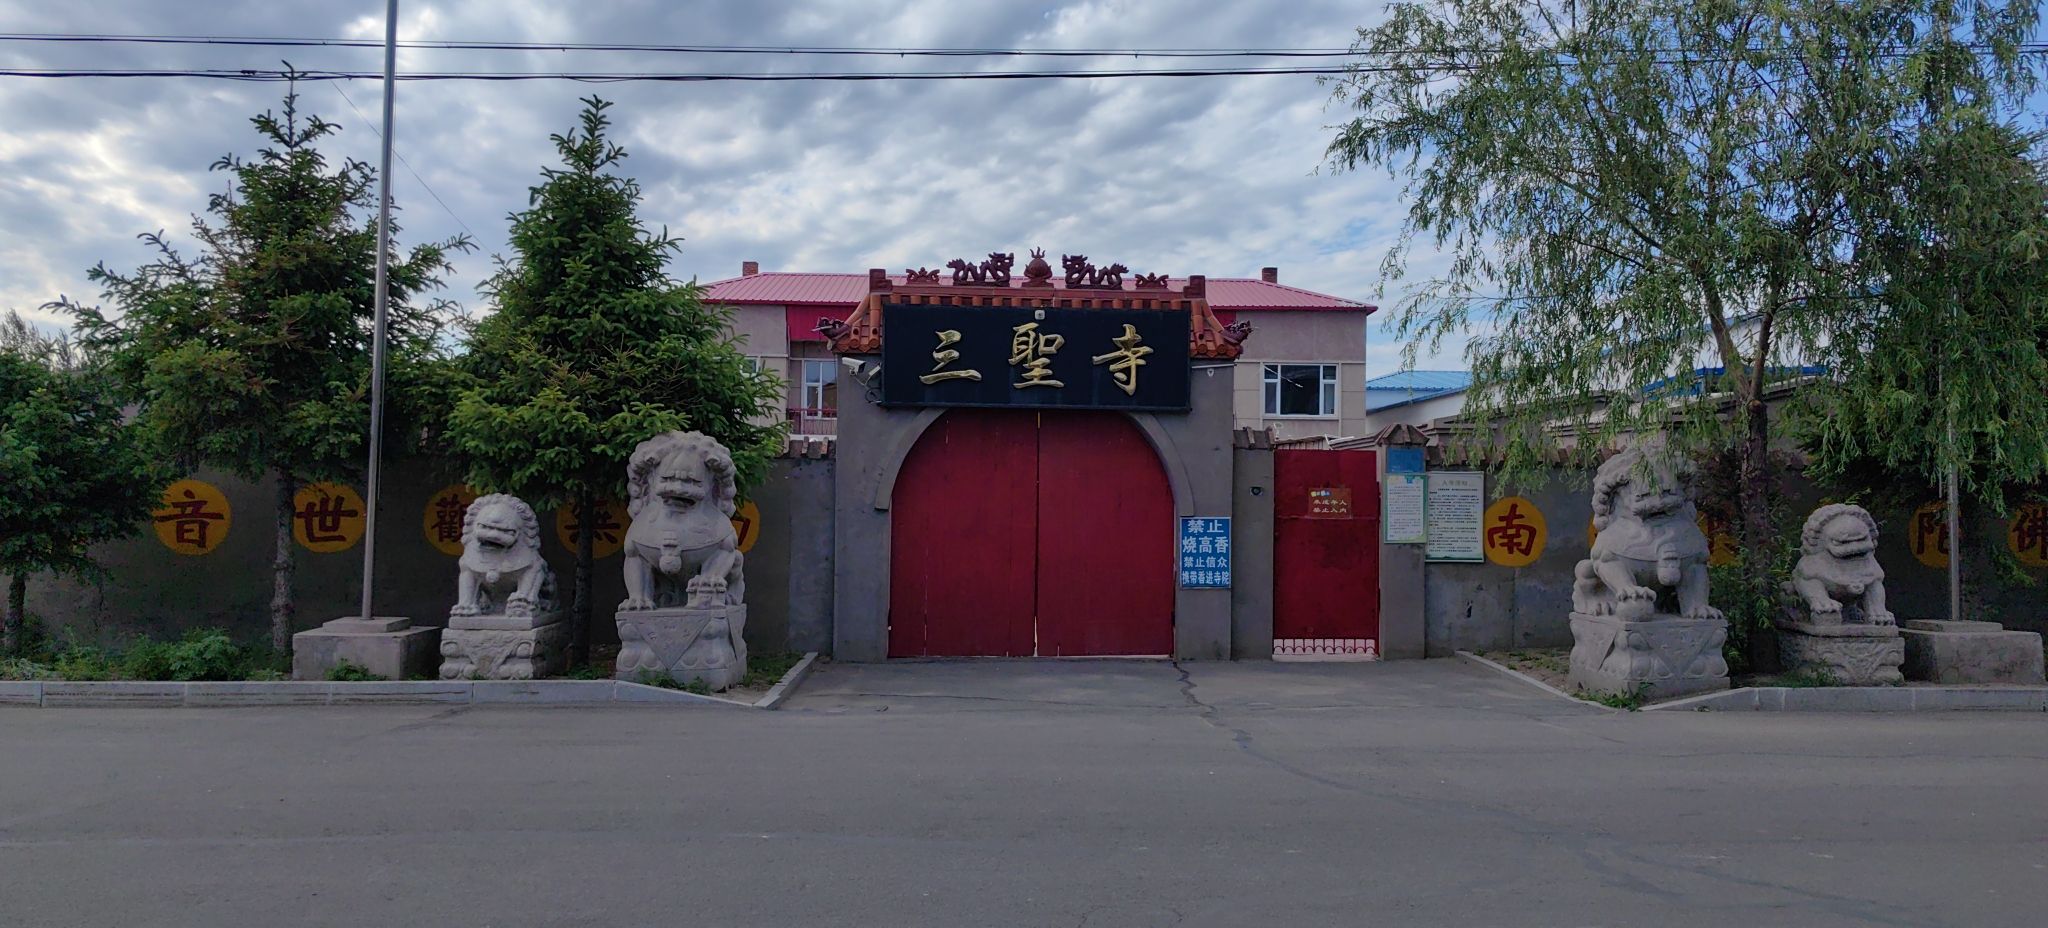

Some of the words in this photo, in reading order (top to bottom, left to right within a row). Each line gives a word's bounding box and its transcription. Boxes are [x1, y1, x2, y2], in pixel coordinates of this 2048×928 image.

[918, 322, 1154, 396] 三聖寺
[155, 488, 225, 548] 音
[296, 495, 359, 542] 世
[1187, 519, 1225, 534] 禁止
[1487, 503, 1537, 556] 南
[1182, 535, 1229, 554] 烧高香
[1183, 556, 1228, 568] 禁止信众
